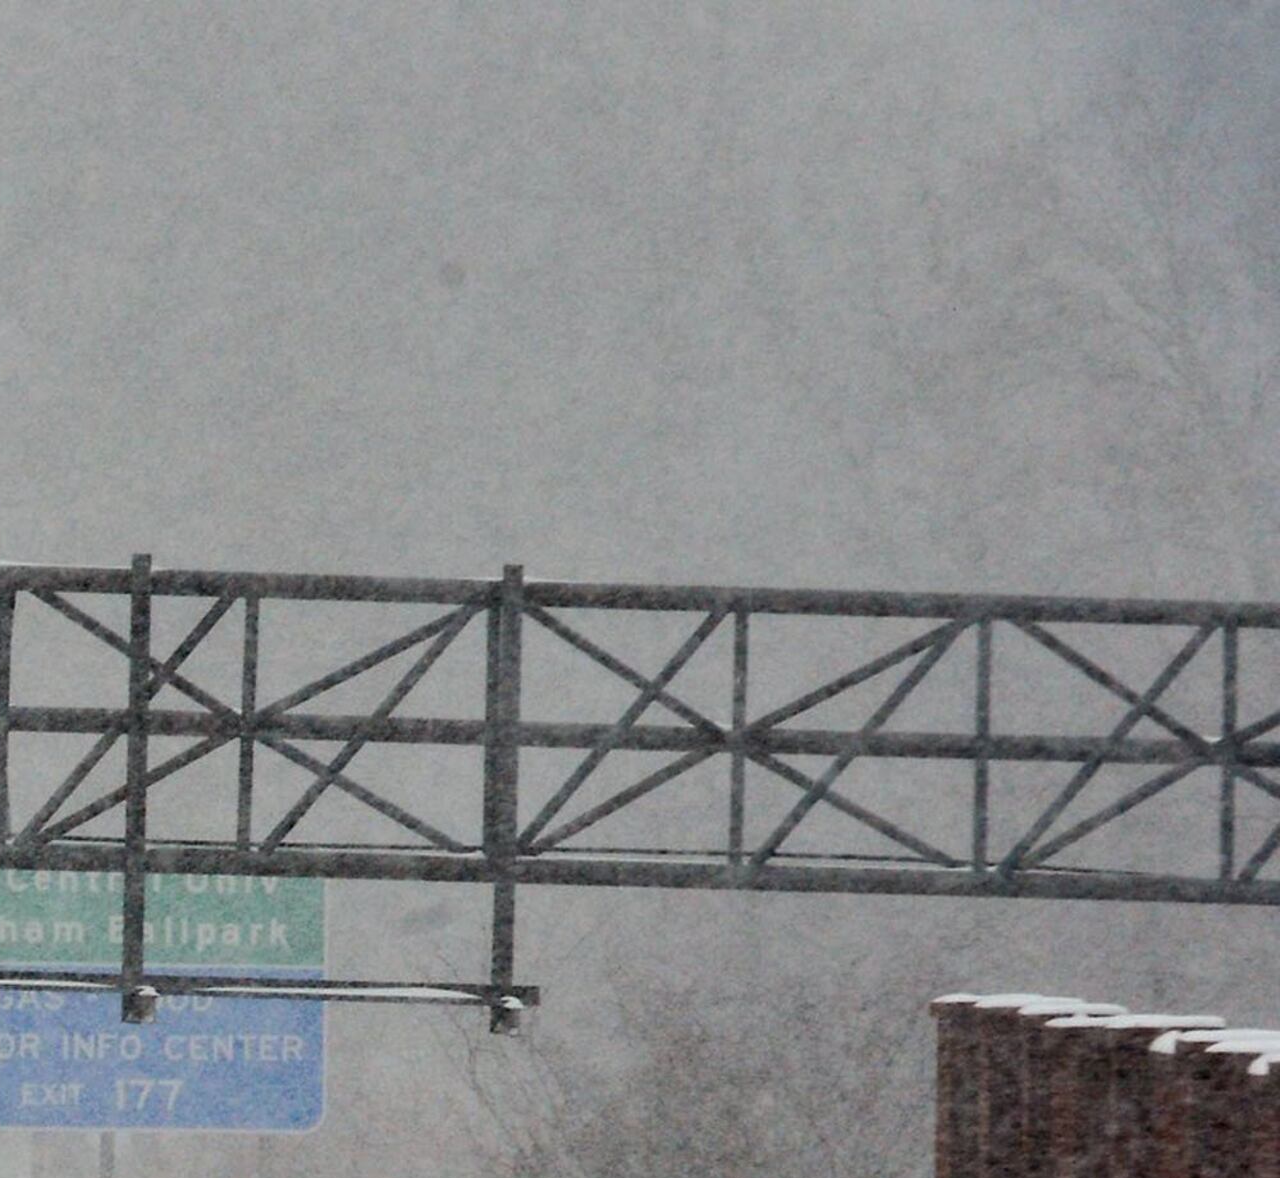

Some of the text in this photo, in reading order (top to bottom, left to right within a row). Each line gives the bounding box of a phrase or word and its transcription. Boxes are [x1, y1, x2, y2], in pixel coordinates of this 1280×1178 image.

[62, 1033, 142, 1061] INFO
[164, 1034, 306, 1063] CENTER
[21, 1078, 185, 1111] EXIT 177
